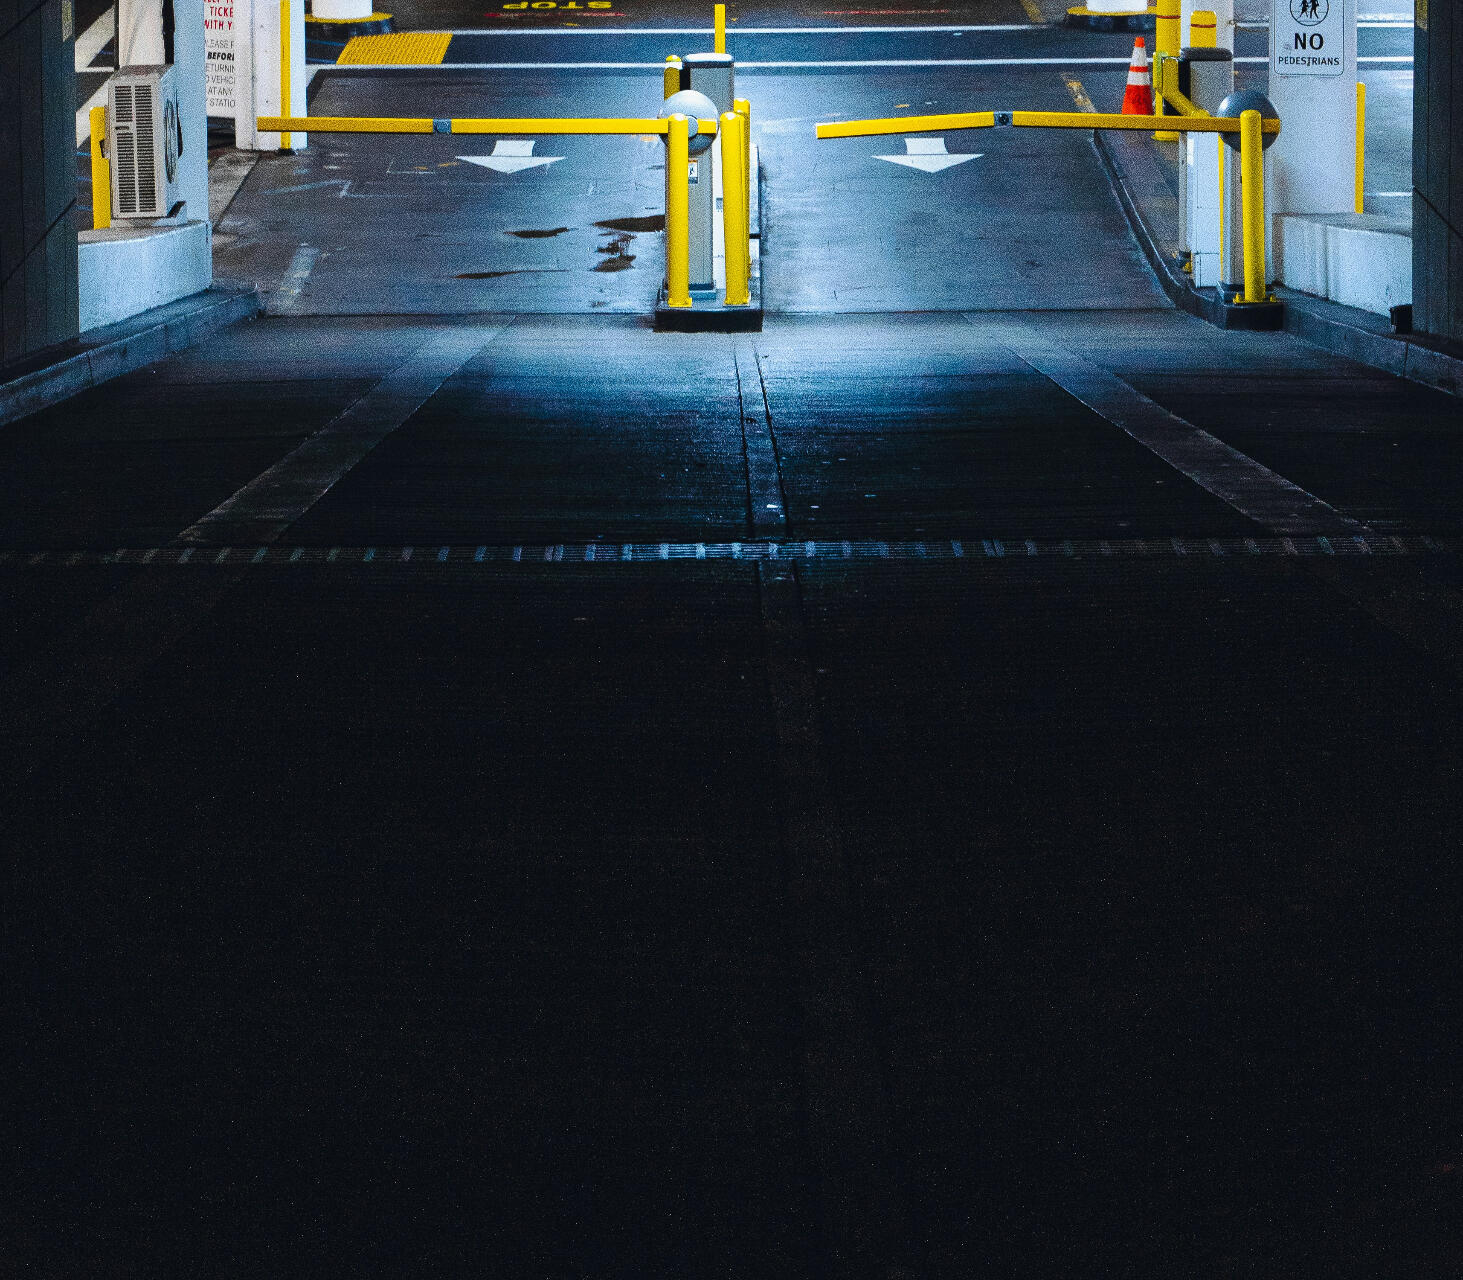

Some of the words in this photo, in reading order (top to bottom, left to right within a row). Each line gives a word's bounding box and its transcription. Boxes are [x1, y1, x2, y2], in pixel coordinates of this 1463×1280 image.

[502, 1, 612, 10] STOP
[1294, 33, 1324, 50] NO
[1278, 56, 1340, 66] PEDESTRIANS
